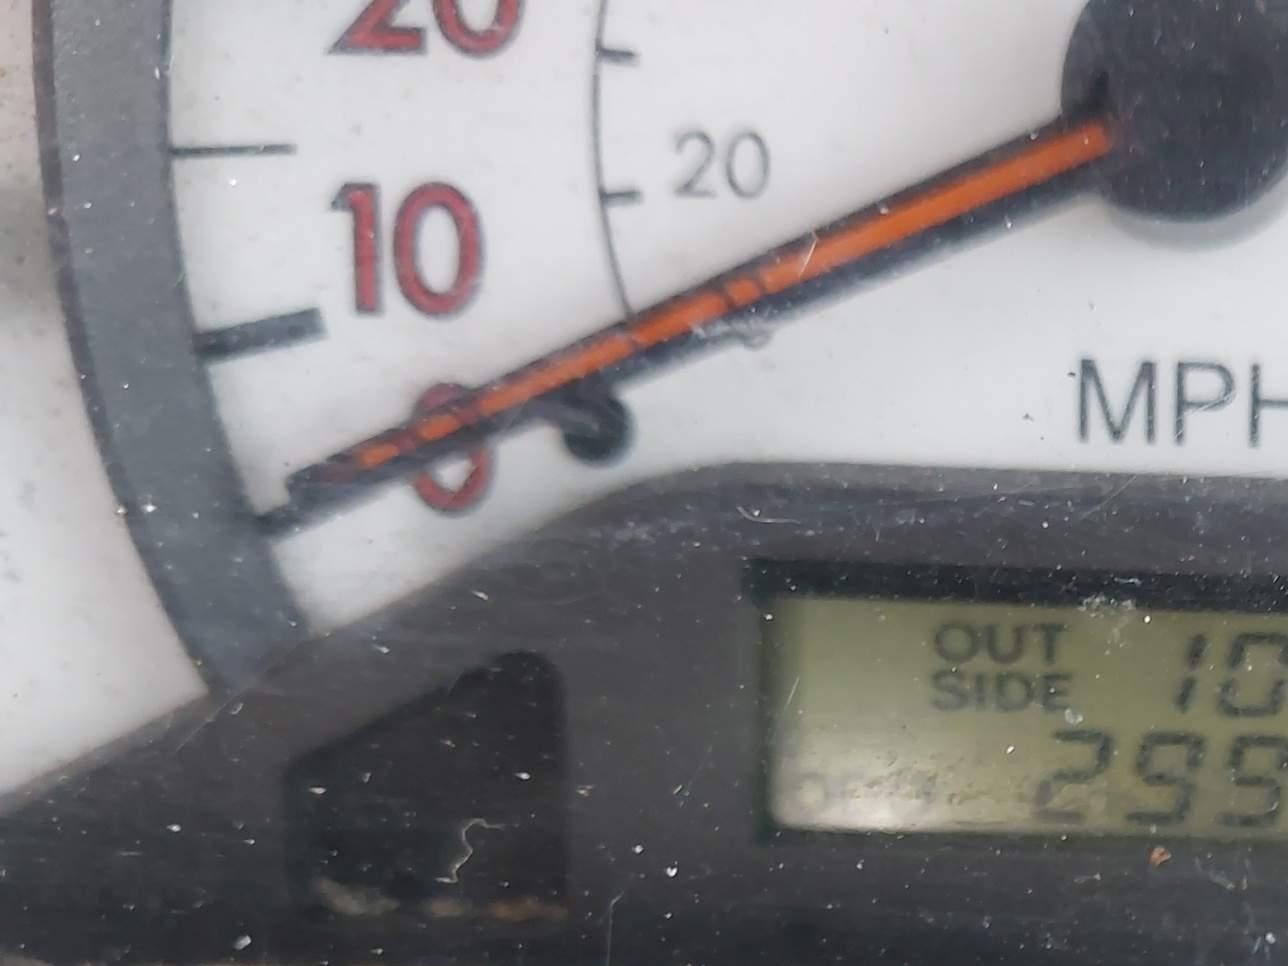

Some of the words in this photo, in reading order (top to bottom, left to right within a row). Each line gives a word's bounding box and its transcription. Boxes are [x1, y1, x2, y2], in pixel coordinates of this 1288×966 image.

[673, 131, 771, 199] 20
[330, 180, 485, 317] 10
[931, 621, 1066, 666] OUT
[930, 671, 1072, 713] SIDE
